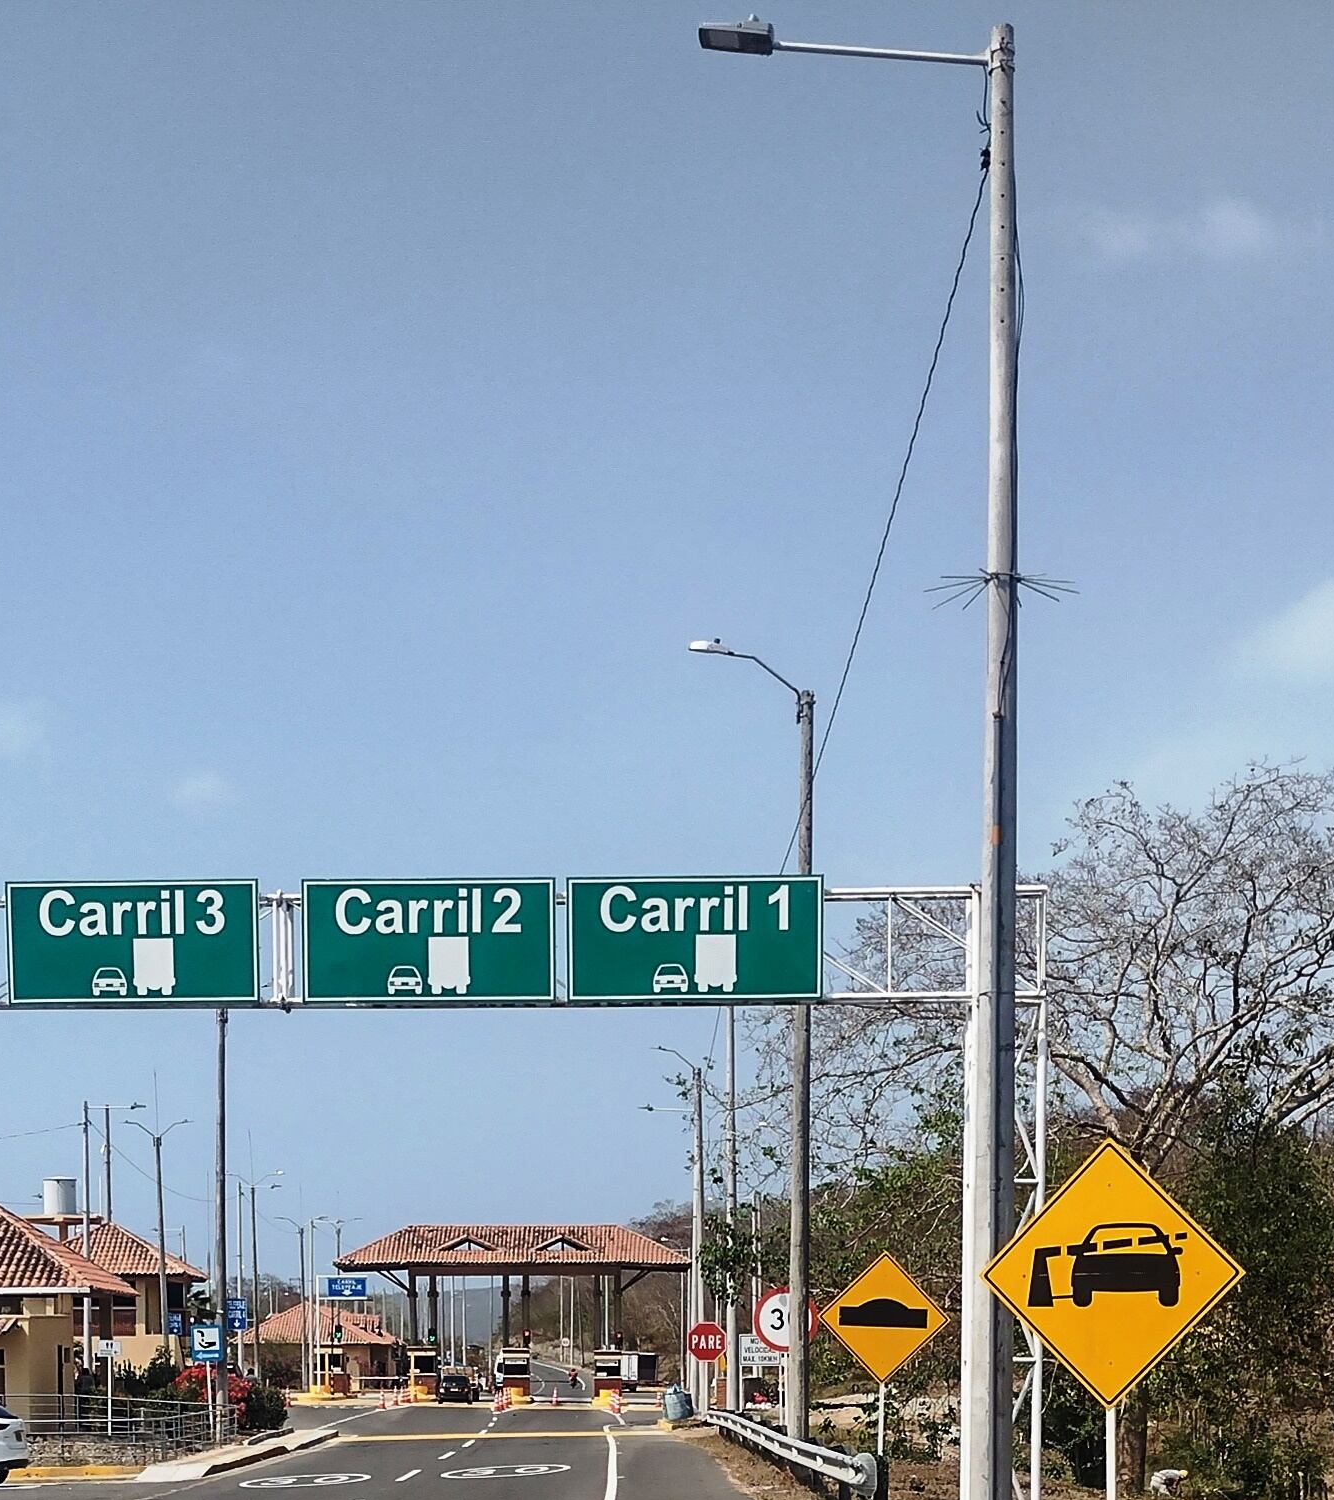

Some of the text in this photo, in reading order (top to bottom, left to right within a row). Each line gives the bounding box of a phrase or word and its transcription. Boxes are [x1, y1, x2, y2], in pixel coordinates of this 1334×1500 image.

[39, 888, 227, 939] Carril 3
[333, 887, 523, 936] Carril 2
[598, 884, 791, 934] Carril 1
[691, 1334, 722, 1350] PARE
